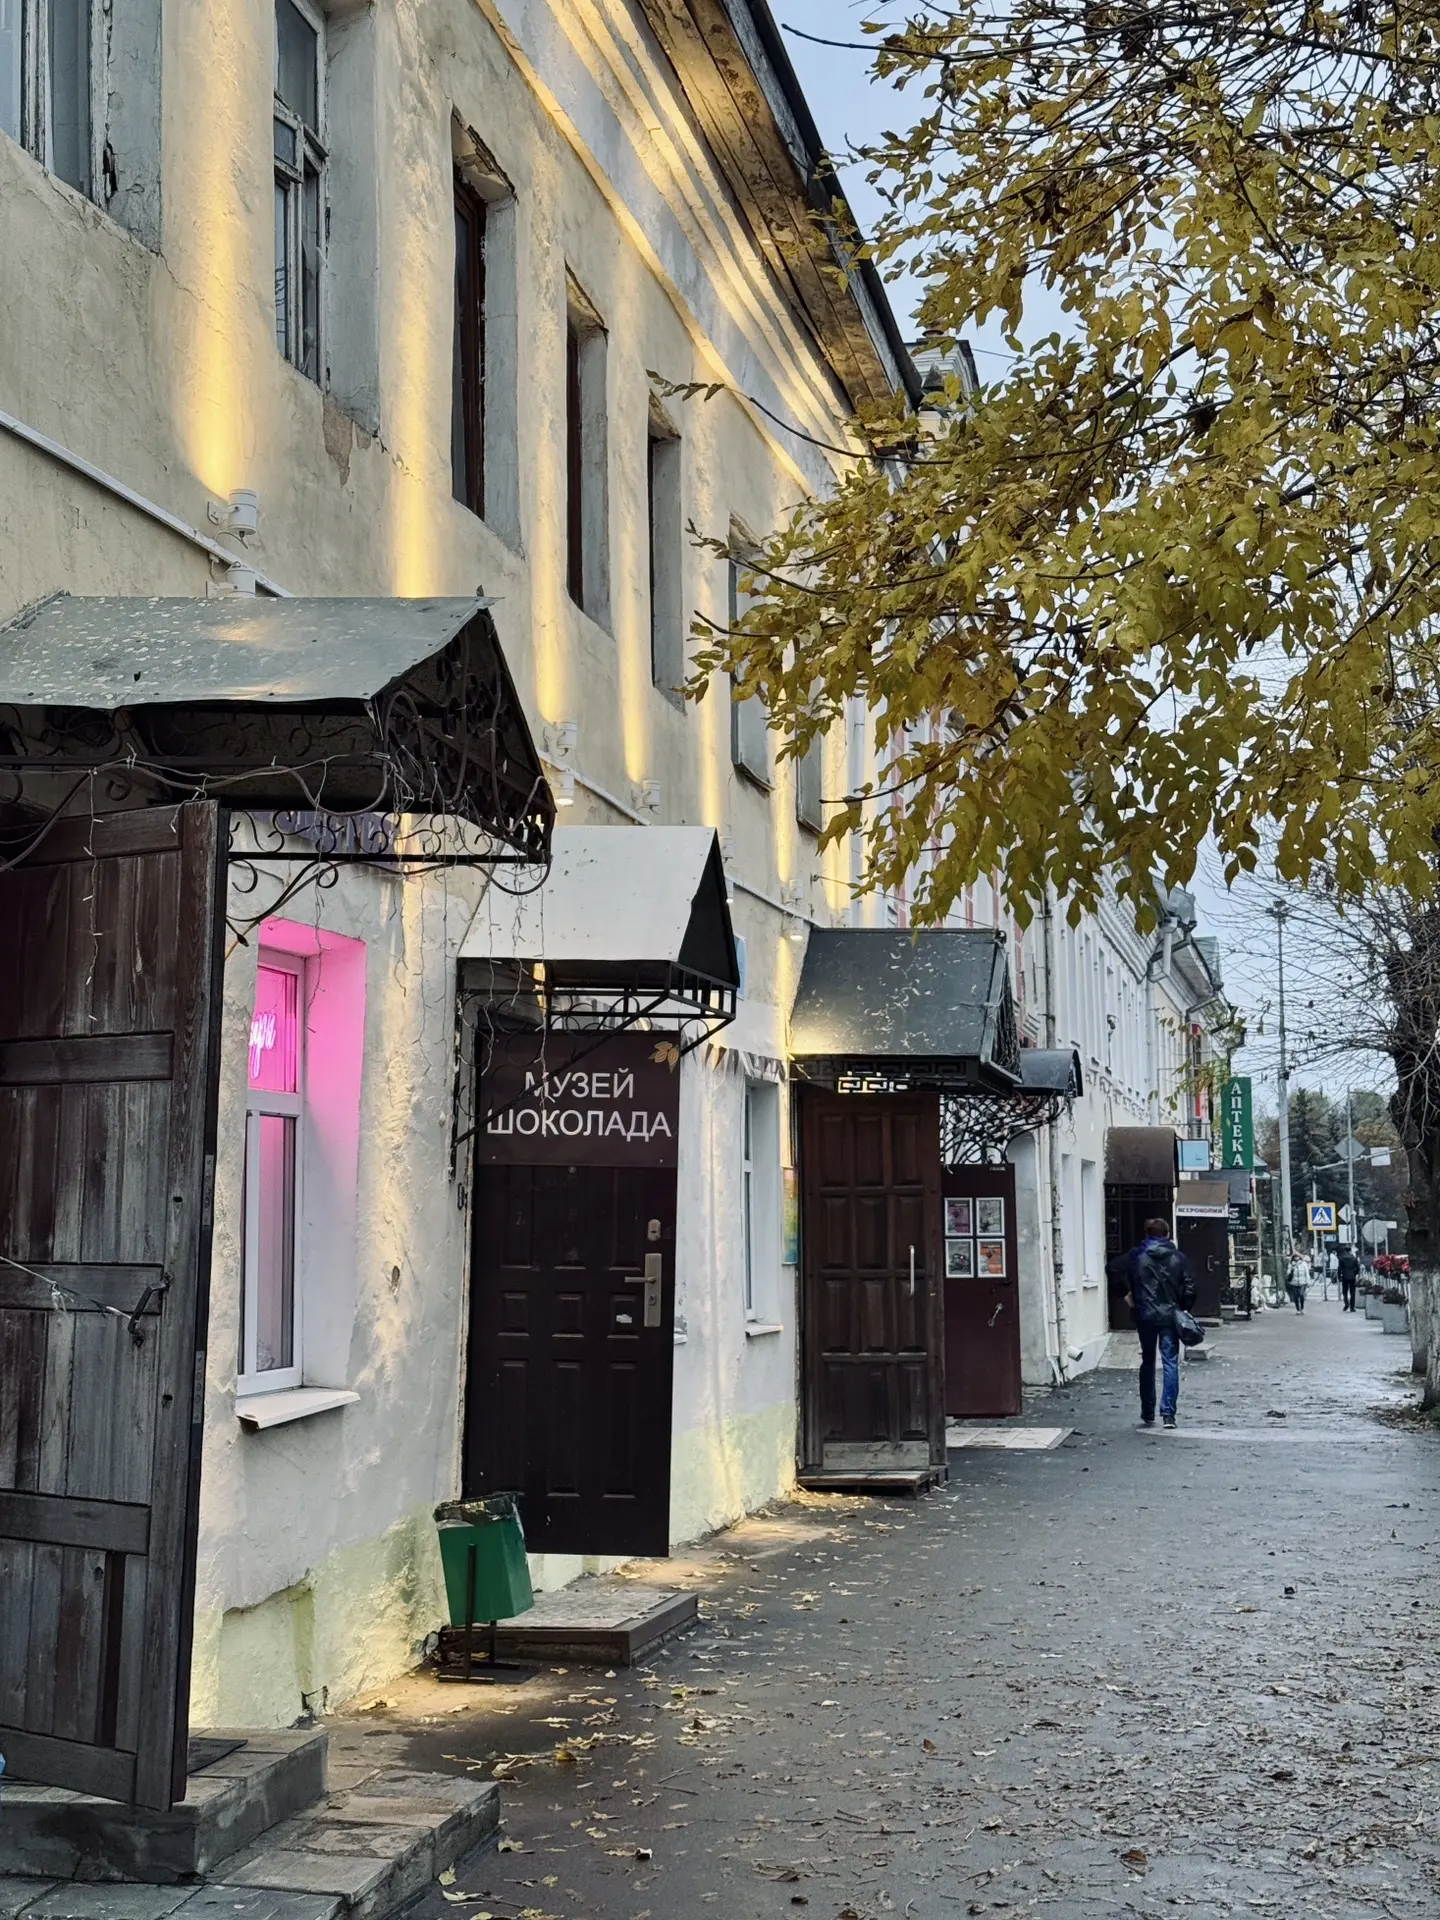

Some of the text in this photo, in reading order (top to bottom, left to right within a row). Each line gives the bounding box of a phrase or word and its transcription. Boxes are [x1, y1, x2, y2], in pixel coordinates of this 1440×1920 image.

[525, 1067, 634, 1099] МУЗЕЙ
[486, 1108, 672, 1142] ШОКОЛАДА
[1230, 1082, 1244, 1166] АПТЕКА
